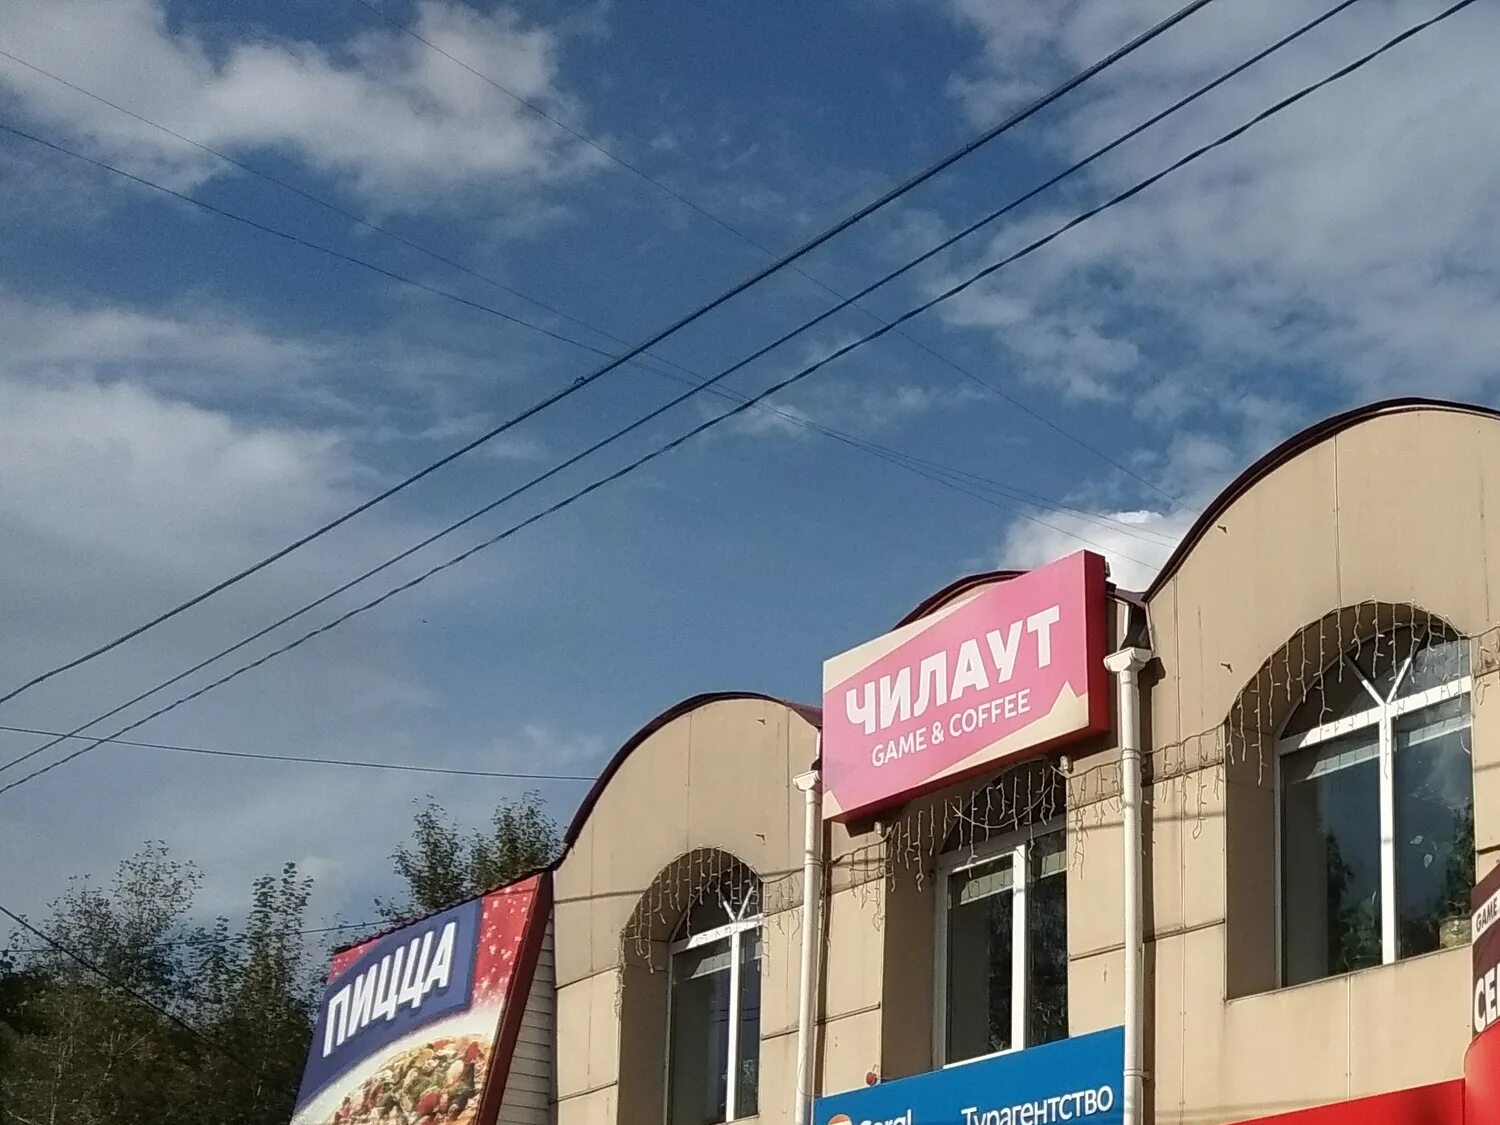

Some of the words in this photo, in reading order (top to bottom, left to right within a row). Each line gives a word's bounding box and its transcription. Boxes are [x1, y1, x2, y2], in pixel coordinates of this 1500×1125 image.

[845, 605, 1060, 735] ЧИЛАУТ
[871, 726, 927, 767] GAME
[932, 721, 945, 745] &
[949, 688, 1031, 738] COFFEE
[1476, 895, 1498, 932] GAME
[321, 922, 457, 1058] ПИЦЦА
